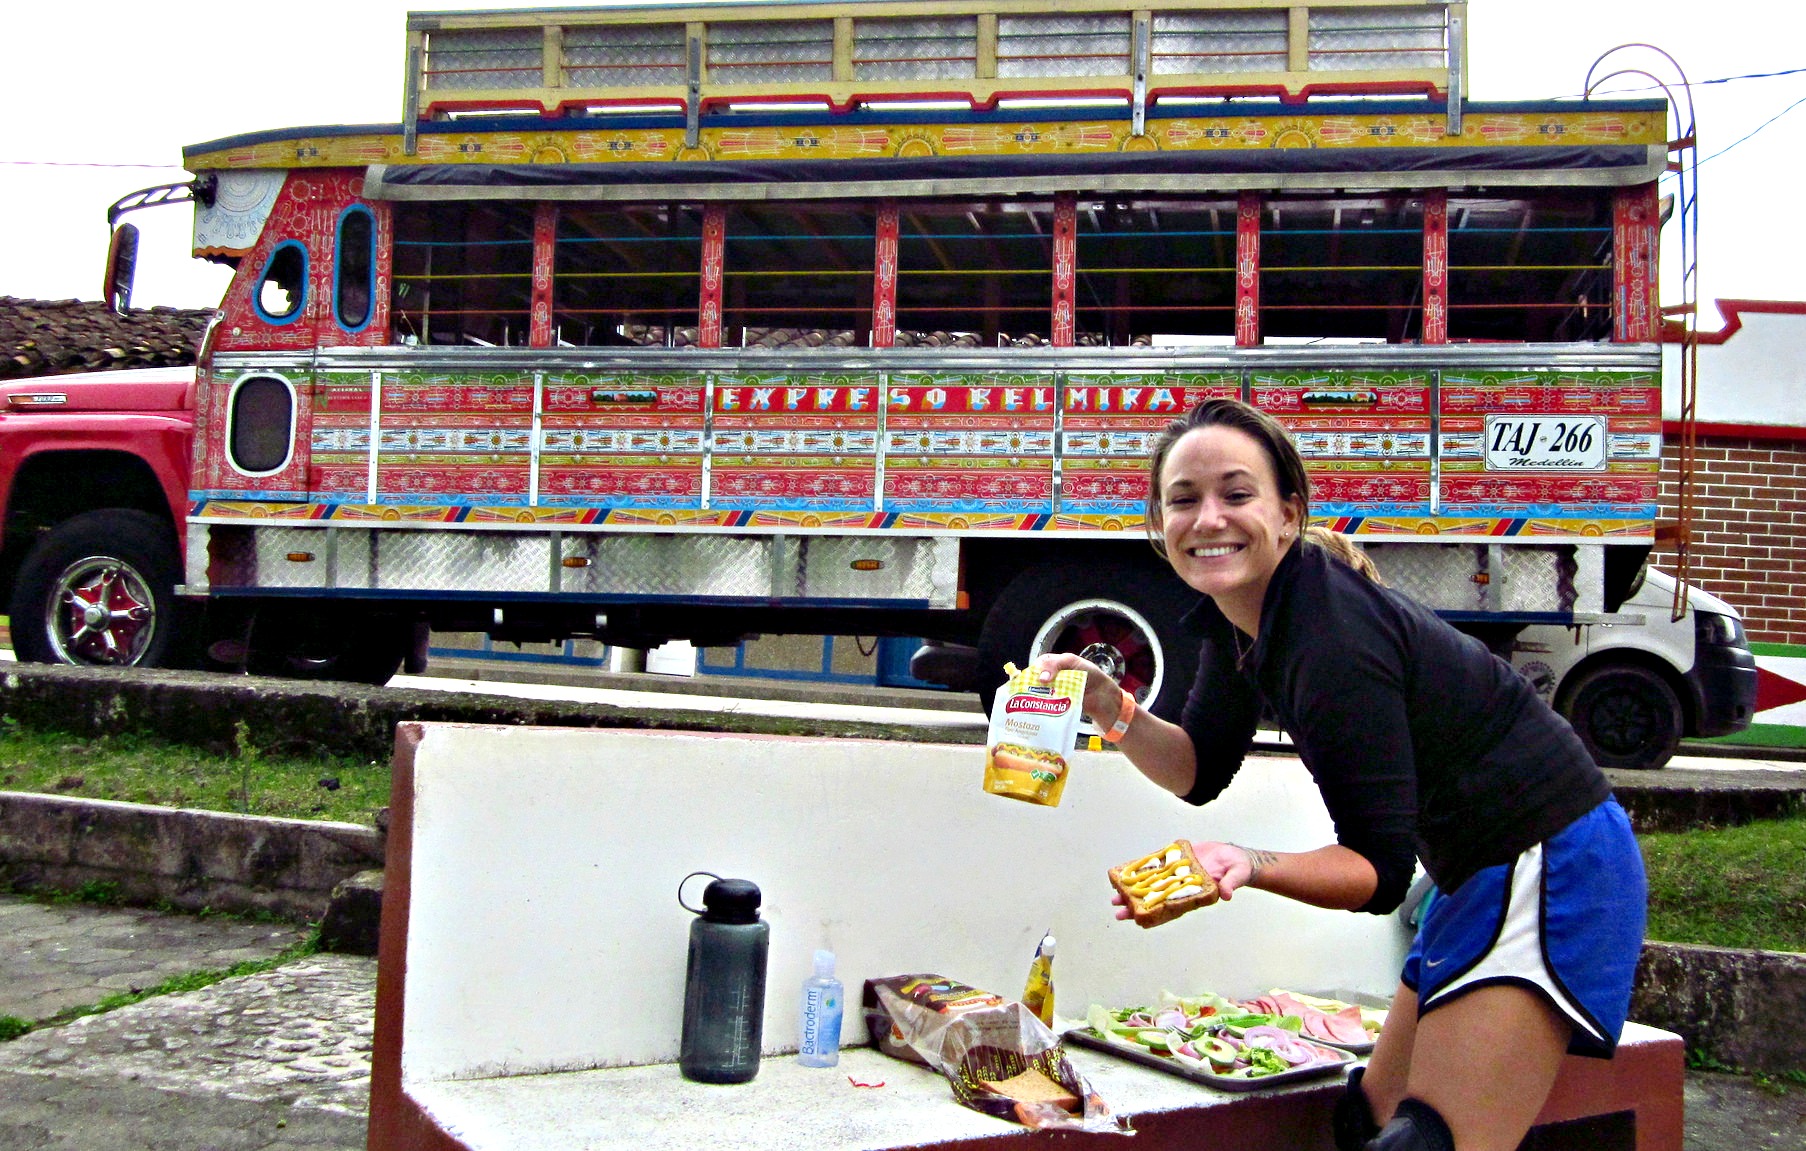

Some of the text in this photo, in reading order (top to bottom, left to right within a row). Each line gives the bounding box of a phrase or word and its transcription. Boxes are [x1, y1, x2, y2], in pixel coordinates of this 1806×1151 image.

[1491, 422, 1597, 456] TAJ 266
[1020, 699, 1067, 712] Constancia
[1005, 718, 1040, 731] Mostaza
[802, 990, 817, 1055] Bactroderm
